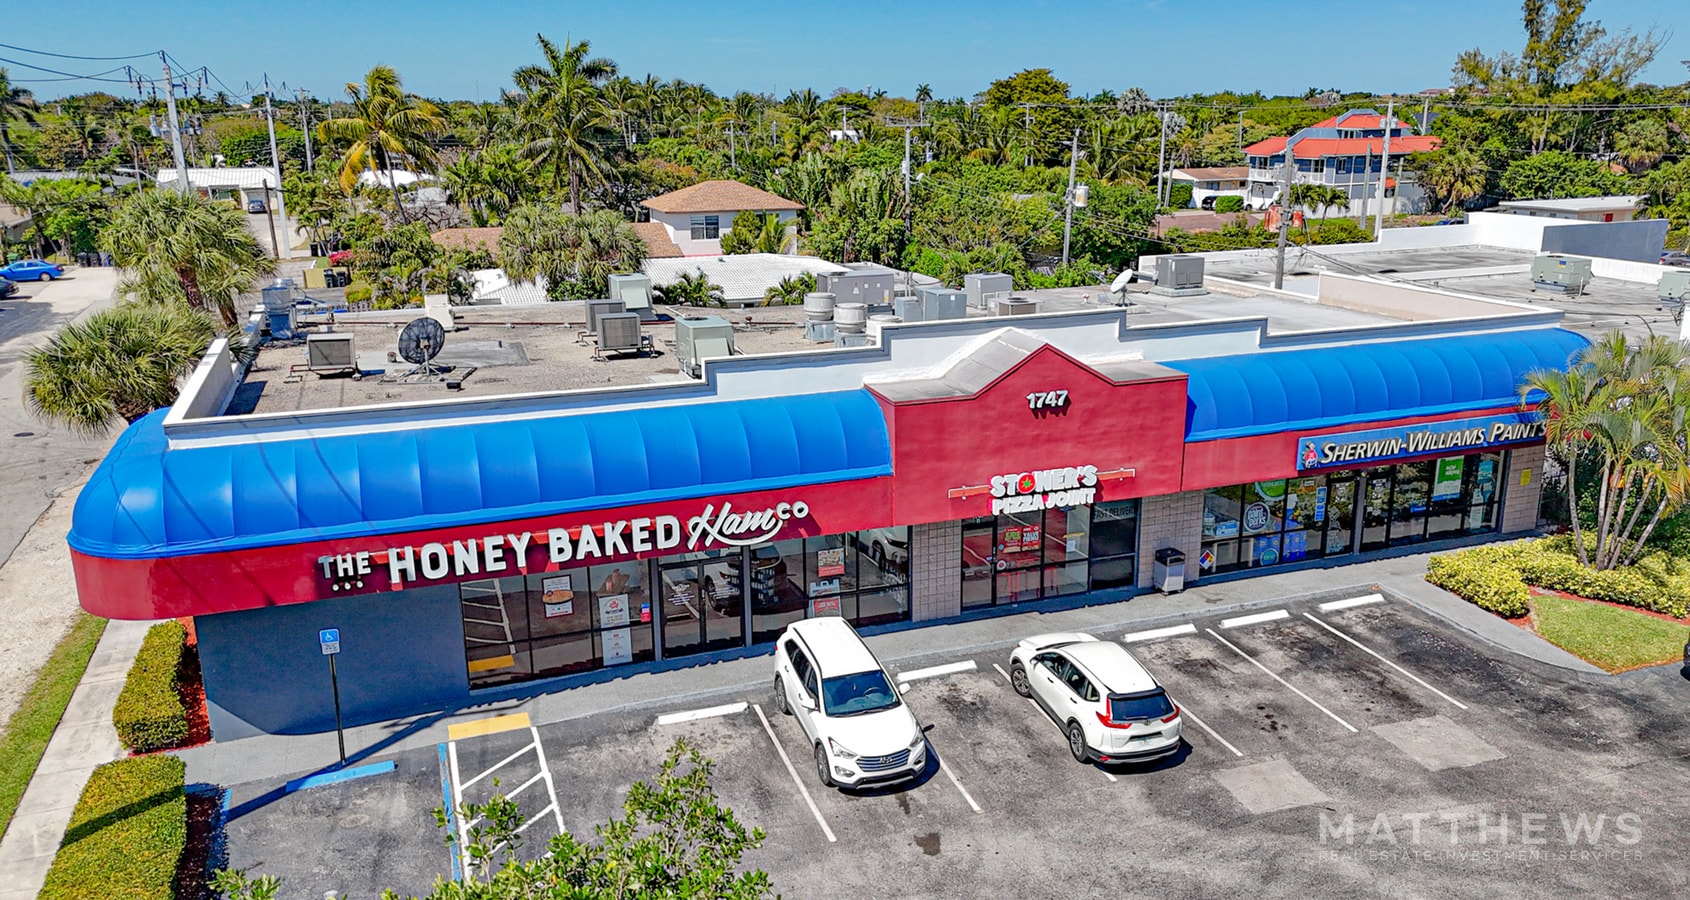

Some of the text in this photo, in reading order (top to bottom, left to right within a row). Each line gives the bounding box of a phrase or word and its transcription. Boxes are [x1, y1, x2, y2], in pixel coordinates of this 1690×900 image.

[1026, 389, 1068, 409] 1747
[990, 465, 1098, 497] STONER'S
[992, 488, 1096, 516] PIZZA JOINT
[317, 551, 371, 578] THE
[388, 531, 531, 583] HONEY
[548, 515, 681, 563] BAKED
[688, 501, 783, 550] Ham
